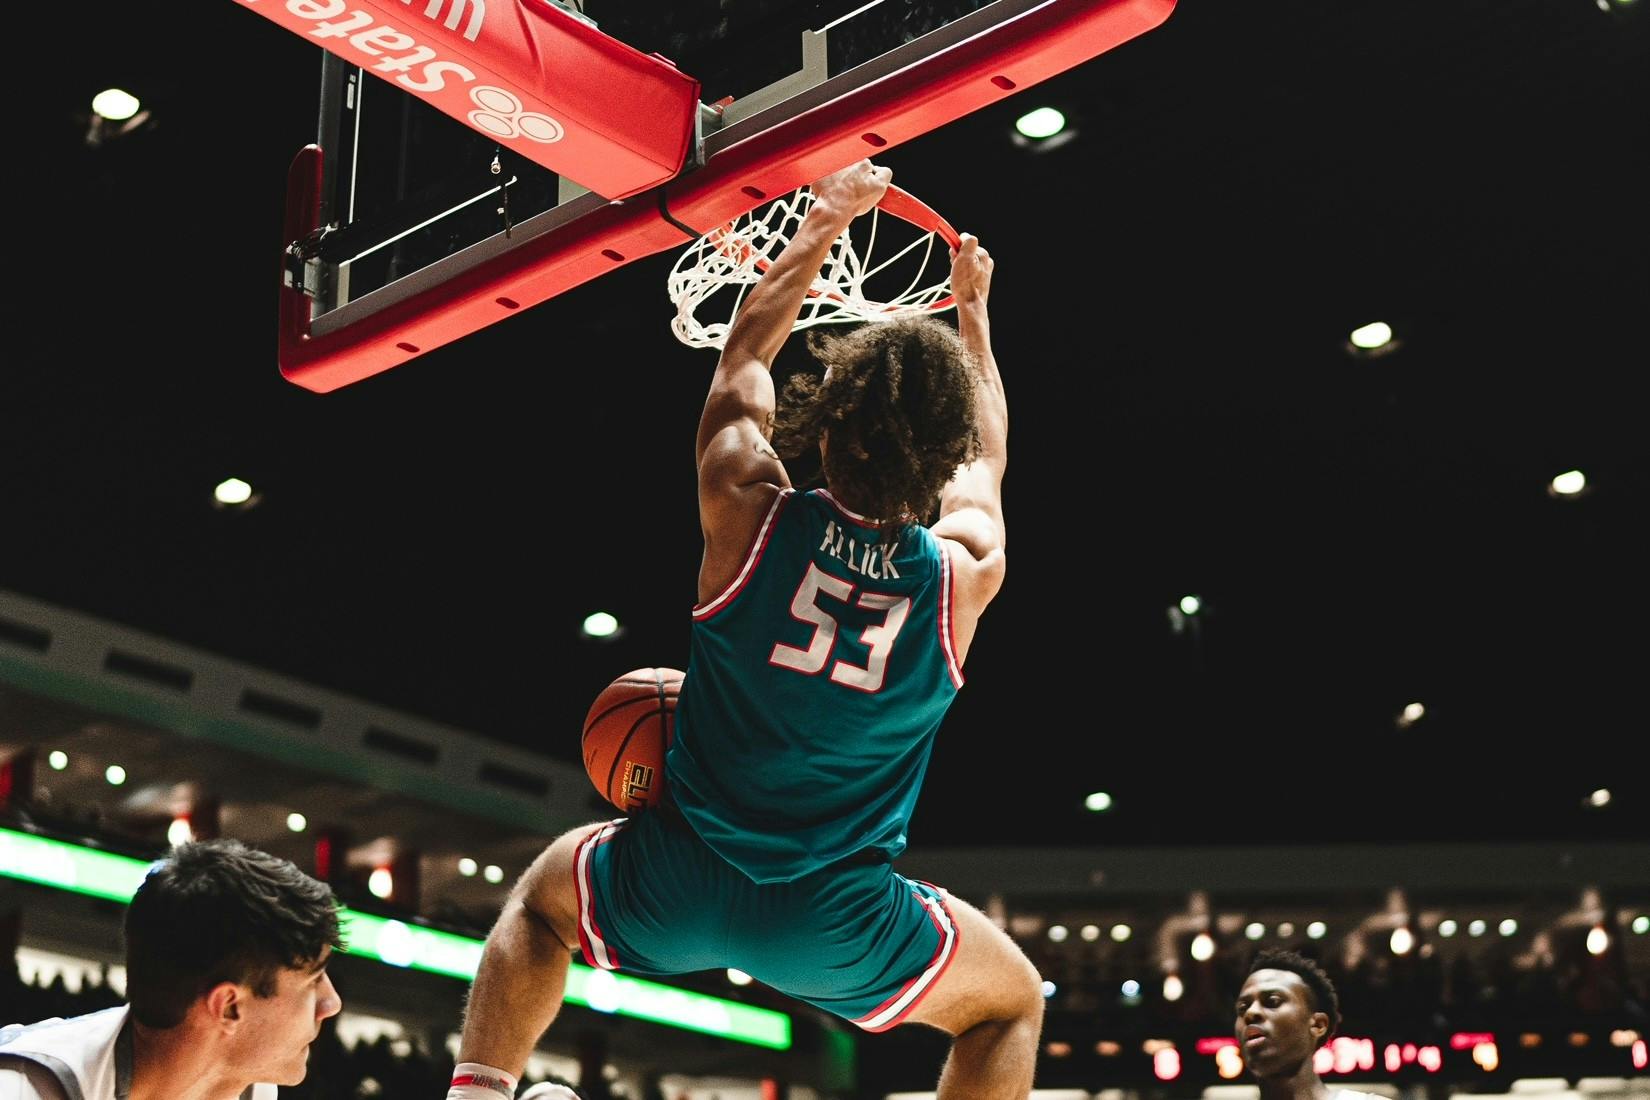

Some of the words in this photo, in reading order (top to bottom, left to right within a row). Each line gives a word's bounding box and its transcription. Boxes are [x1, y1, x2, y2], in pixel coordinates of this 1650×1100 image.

[285, 0, 476, 92] State
[819, 520, 900, 580] ALLICK
[768, 560, 912, 694] 53
